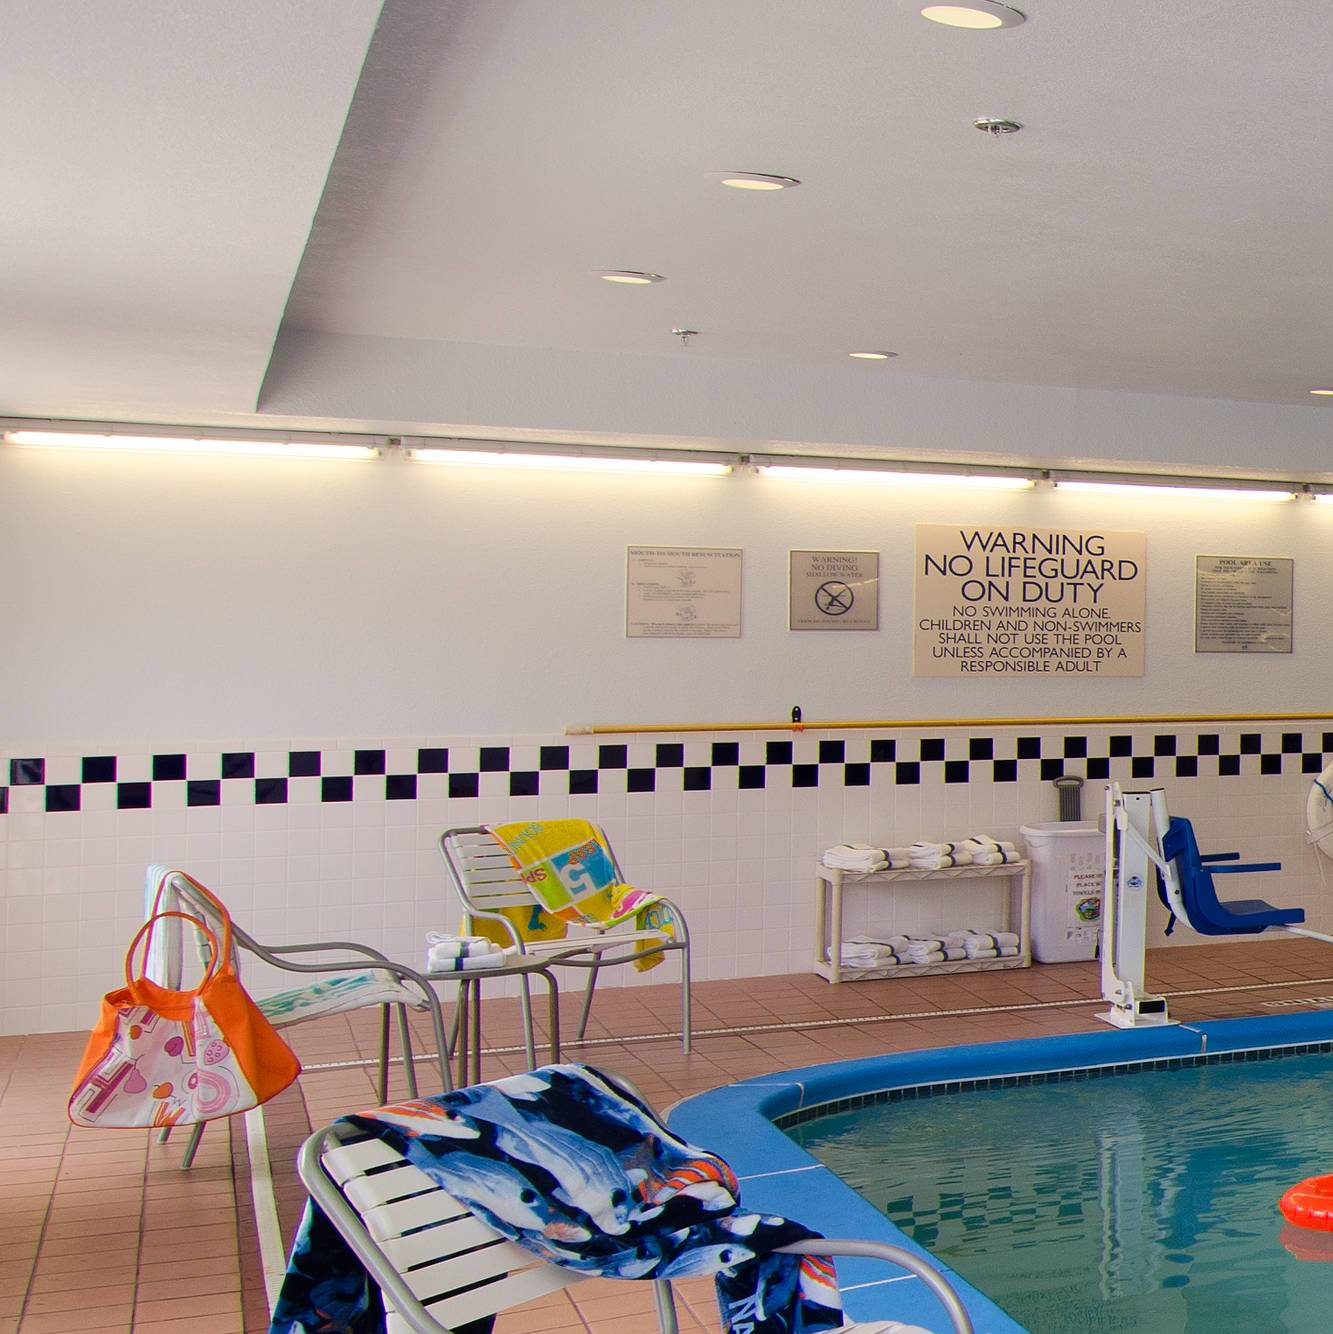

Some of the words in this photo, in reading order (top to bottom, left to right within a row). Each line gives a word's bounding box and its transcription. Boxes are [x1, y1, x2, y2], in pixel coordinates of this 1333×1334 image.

[960, 531, 1105, 557] WARNING
[826, 564, 858, 572] DIVING
[924, 554, 973, 577] NO
[986, 556, 1138, 581] LIFEGUARD
[961, 580, 1009, 602] ON
[1022, 581, 1104, 604] DUTY
[953, 606, 977, 618] NO
[982, 606, 1057, 619] SWIMMING
[1062, 607, 1111, 619] ALONE.
[919, 619, 992, 631] CHILDREN
[996, 620, 1029, 631] AND
[1033, 620, 1142, 633] NON-SWIMMERS
[939, 633, 982, 645] SHALL
[987, 633, 1019, 645] NOT
[1024, 634, 1049, 645] USE
[1054, 634, 1079, 645] THE
[1084, 634, 1122, 645] POOL
[932, 647, 984, 659] UNLESS
[989, 647, 1091, 659] ACCOMPANIED
[1097, 648, 1112, 659] BY
[1117, 648, 1128, 658] A
[960, 661, 1050, 672] RESPONSIBLE
[1055, 661, 1101, 672] ADULT
